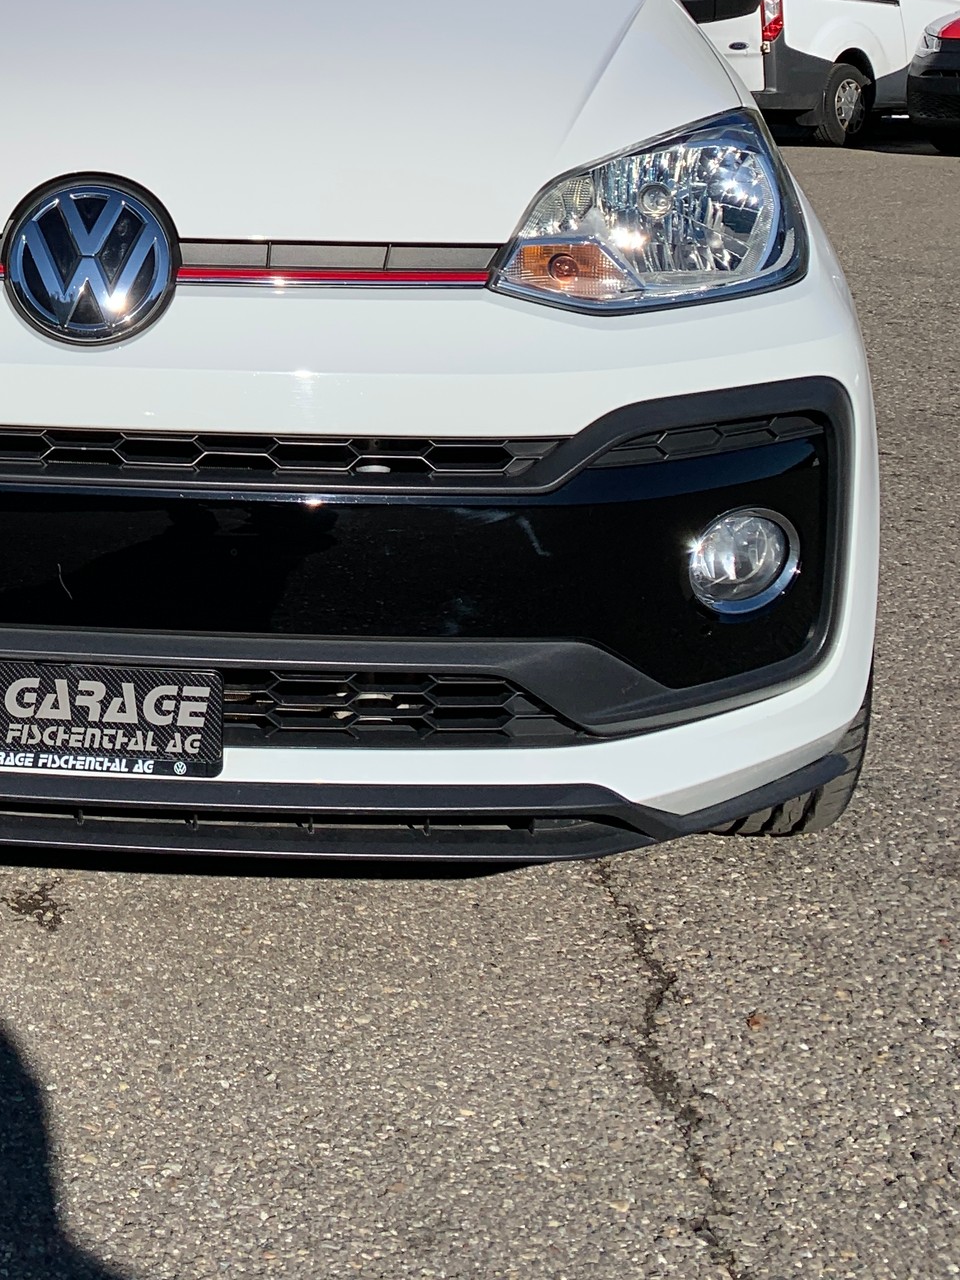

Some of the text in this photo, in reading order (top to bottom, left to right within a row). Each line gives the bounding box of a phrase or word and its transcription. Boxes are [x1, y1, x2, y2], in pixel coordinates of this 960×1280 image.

[4, 677, 211, 728] GARAGE
[5, 723, 202, 755] FISCHENTHAL AG
[37, 754, 129, 773] FISCHENTHAL
[133, 759, 154, 774] AG
